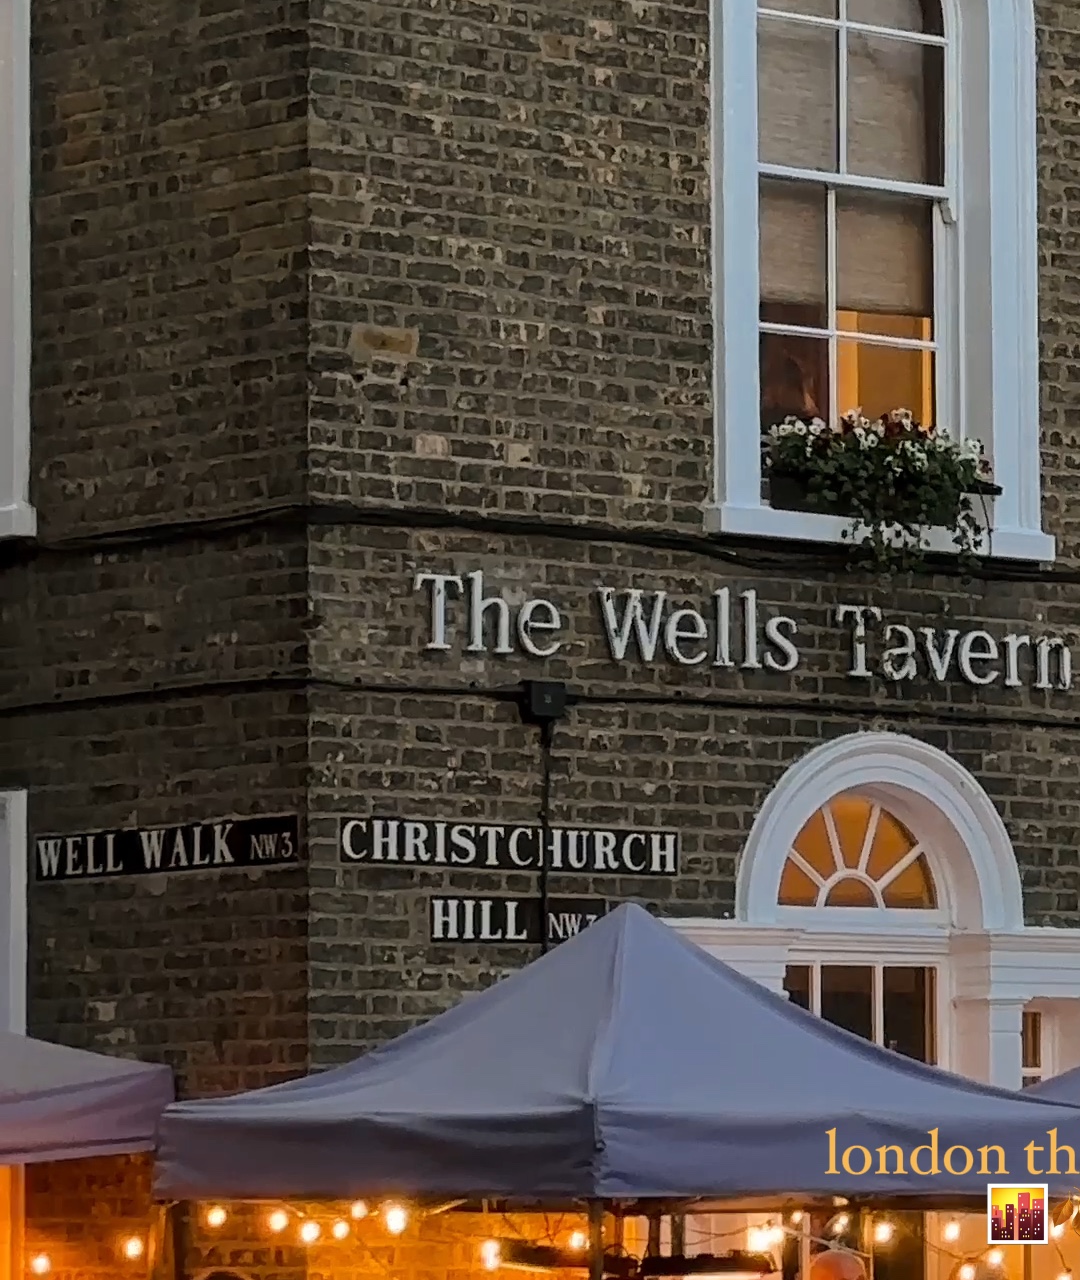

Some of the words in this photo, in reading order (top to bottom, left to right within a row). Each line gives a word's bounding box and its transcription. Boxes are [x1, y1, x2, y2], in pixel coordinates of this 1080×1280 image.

[414, 570, 561, 657] The
[596, 586, 799, 670] Wells
[836, 604, 1071, 690] Tavern
[37, 833, 123, 877] WELL
[139, 823, 235, 869] WALK
[342, 820, 676, 872] CHRISTCHURCH
[432, 899, 527, 940] HILL
